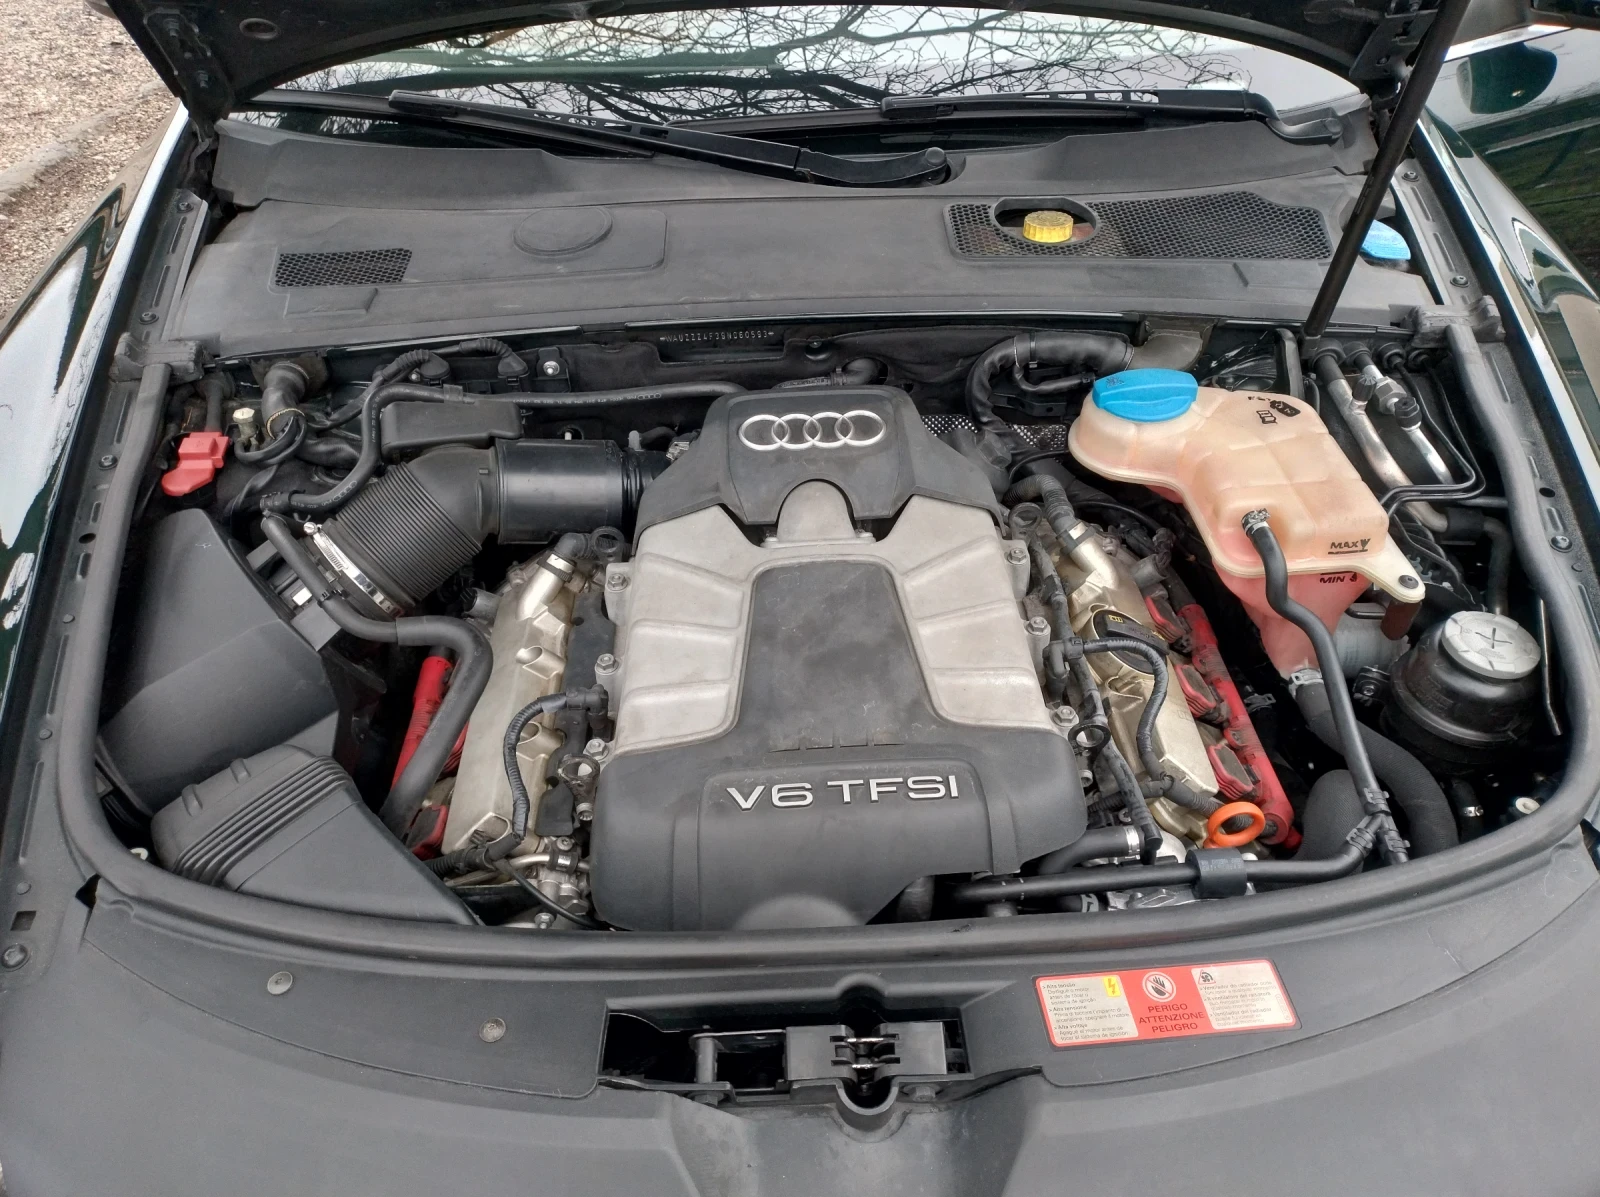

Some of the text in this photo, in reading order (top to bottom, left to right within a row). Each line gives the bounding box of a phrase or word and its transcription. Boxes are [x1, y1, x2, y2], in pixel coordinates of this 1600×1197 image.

[1330, 540, 1359, 549] MAX
[1319, 575, 1346, 583] MIN
[726, 775, 959, 812] V6 TFSI
[1148, 1003, 1188, 1013] PERIGO
[1139, 1012, 1205, 1024] ATTENZIONE
[1152, 1022, 1198, 1033] PELIGRO
